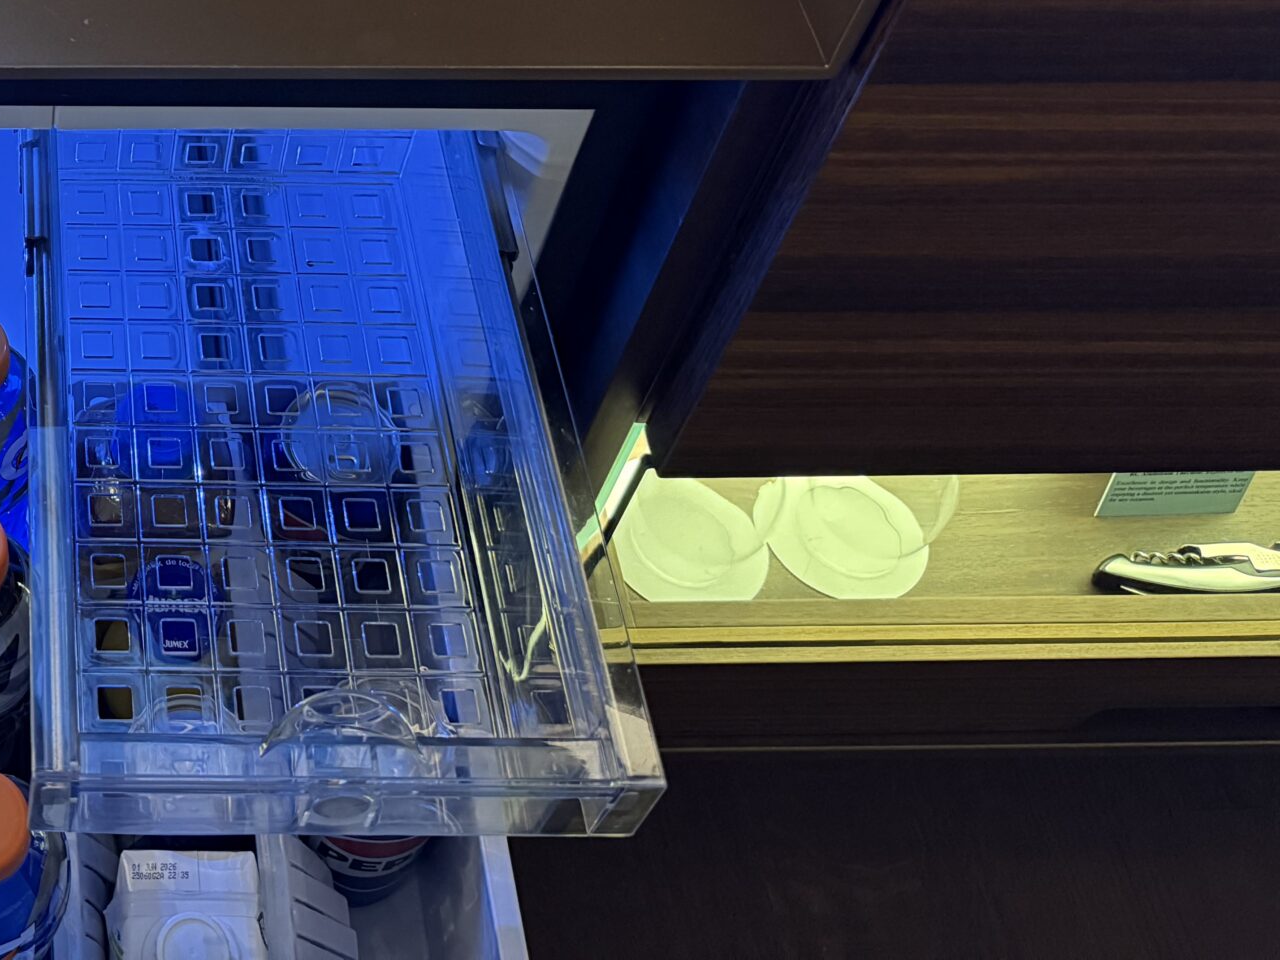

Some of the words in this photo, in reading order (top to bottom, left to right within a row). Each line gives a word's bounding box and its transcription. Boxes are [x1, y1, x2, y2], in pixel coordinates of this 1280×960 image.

[162, 639, 189, 649] JUMEX
[131, 863, 140, 872] 01
[160, 862, 177, 871] 2026
